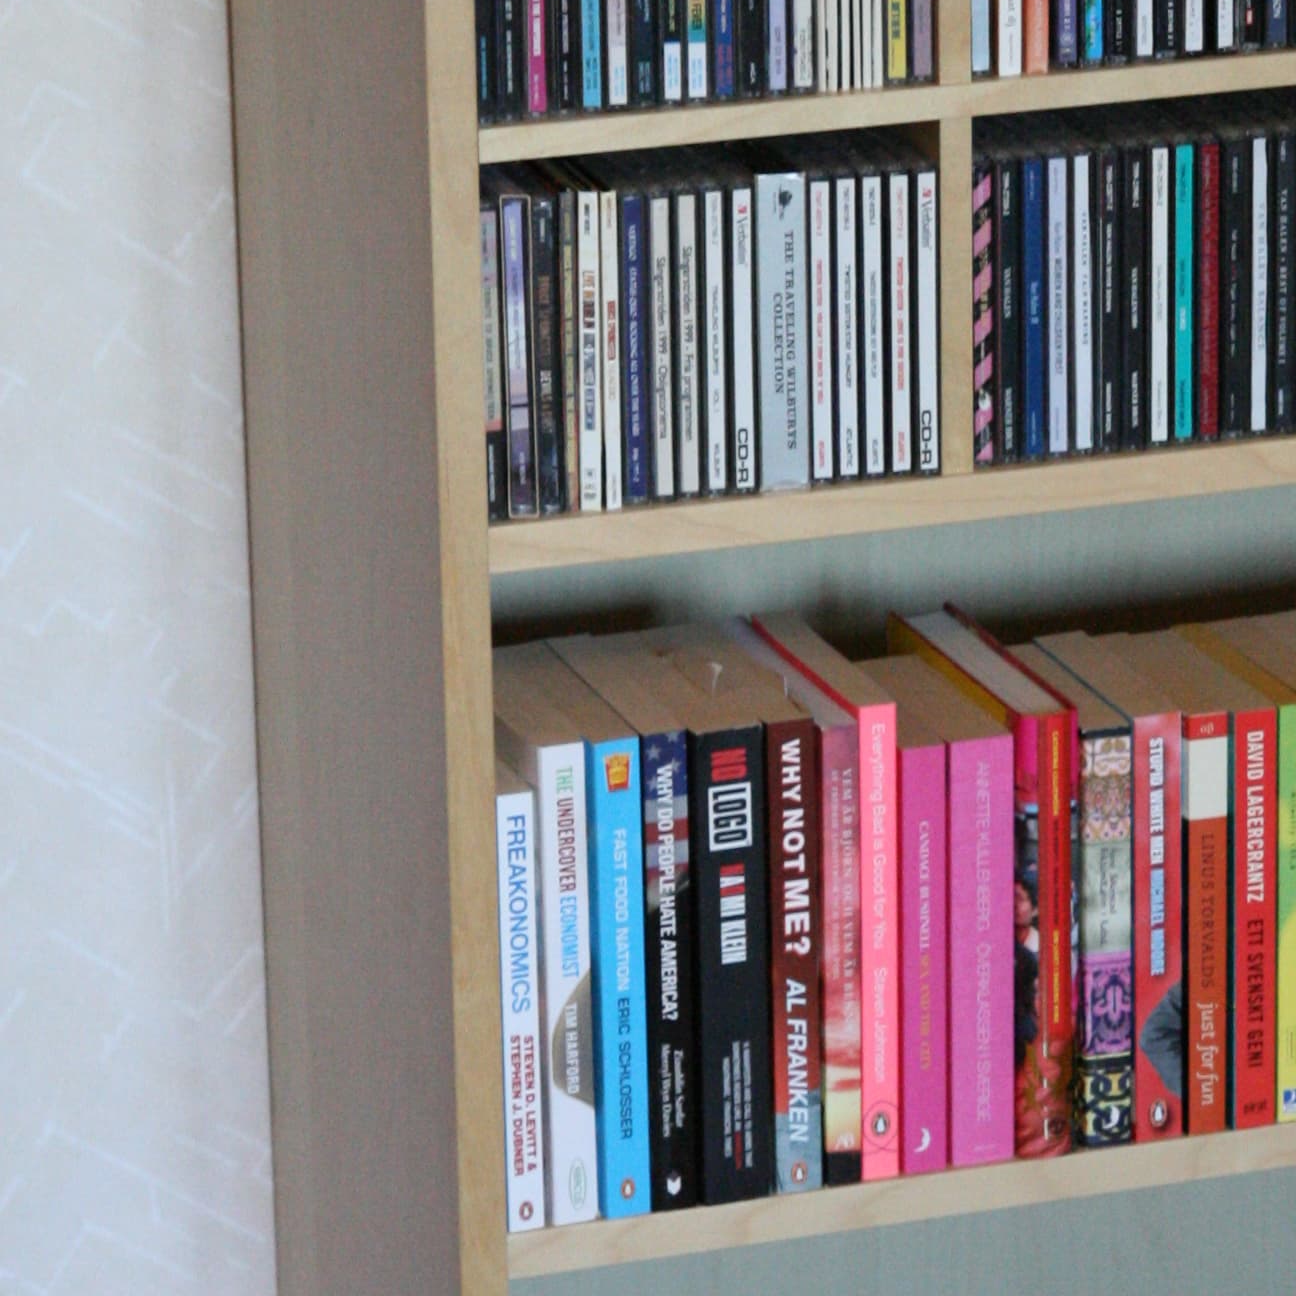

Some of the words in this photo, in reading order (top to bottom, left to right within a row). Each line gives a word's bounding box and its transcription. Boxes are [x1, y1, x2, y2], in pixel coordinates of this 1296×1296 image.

[691, 3, 702, 31] FEVER
[736, 216, 748, 264] Verbatim
[784, 230, 794, 263] THE
[921, 200, 933, 247] Verbatim
[654, 257, 669, 326] Sångarstriden
[680, 246, 694, 316] Sångarstriden
[683, 319, 694, 344] 1999
[784, 269, 796, 359] TRAVELING
[657, 329, 669, 354] 1999
[684, 353, 695, 373] Fria
[773, 292, 784, 393] COLLECTION
[655, 366, 670, 439] Obligatorierna
[680, 376, 693, 441] programmen
[786, 366, 797, 449] WILBURYS
[737, 428, 749, 483] CD-R
[921, 410, 933, 464] CD-R
[711, 749, 747, 782] NO
[779, 739, 803, 806] WHY
[869, 723, 887, 801] Everything
[1149, 738, 1164, 787] STUPID
[1246, 731, 1265, 780] DAVID
[556, 766, 574, 793] THE
[655, 764, 677, 804] WHY
[657, 808, 676, 830] DO
[712, 786, 749, 847] LOGO
[871, 805, 887, 834] Bad
[1150, 789, 1164, 834] WHITE
[557, 797, 577, 892] UNDERCOVER
[613, 828, 629, 871] FAST
[782, 809, 806, 872] NOT
[872, 838, 887, 849] is
[1150, 837, 1165, 865] MEN
[1245, 785, 1264, 904] LAGERCRANTZ
[657, 834, 676, 895] PEOPLE
[872, 853, 887, 893] Good
[505, 814, 530, 1014] FREAKONOMICS
[613, 876, 630, 922] FOOD
[658, 897, 677, 936] HATE
[783, 879, 810, 955] ME?
[872, 895, 888, 916] for
[1150, 869, 1165, 926] MICHAEL
[559, 895, 579, 979] ECONOMIST
[872, 921, 887, 949] You
[1151, 930, 1166, 976] MOORE
[614, 928, 631, 991] NATION
[659, 940, 678, 1021] AMERICA?
[564, 1002, 579, 1027] TIM
[616, 997, 632, 1036] ERIC
[786, 979, 807, 1012] AL
[1195, 1002, 1217, 1040] just
[510, 1035, 522, 1099] STEPHEN
[523, 1035, 535, 1089] STEVEN
[565, 1029, 581, 1094] HARFORD
[1197, 1044, 1218, 1069] for
[524, 1093, 535, 1107] D.
[618, 1041, 635, 1139] SCHLOSSER
[786, 1019, 808, 1142] FRANKEN
[1197, 1072, 1218, 1105] fun
[511, 1104, 523, 1114] J.
[512, 1117, 525, 1177] DUBNER
[524, 1110, 536, 1157] LEVITT
[526, 1161, 537, 1172] &
